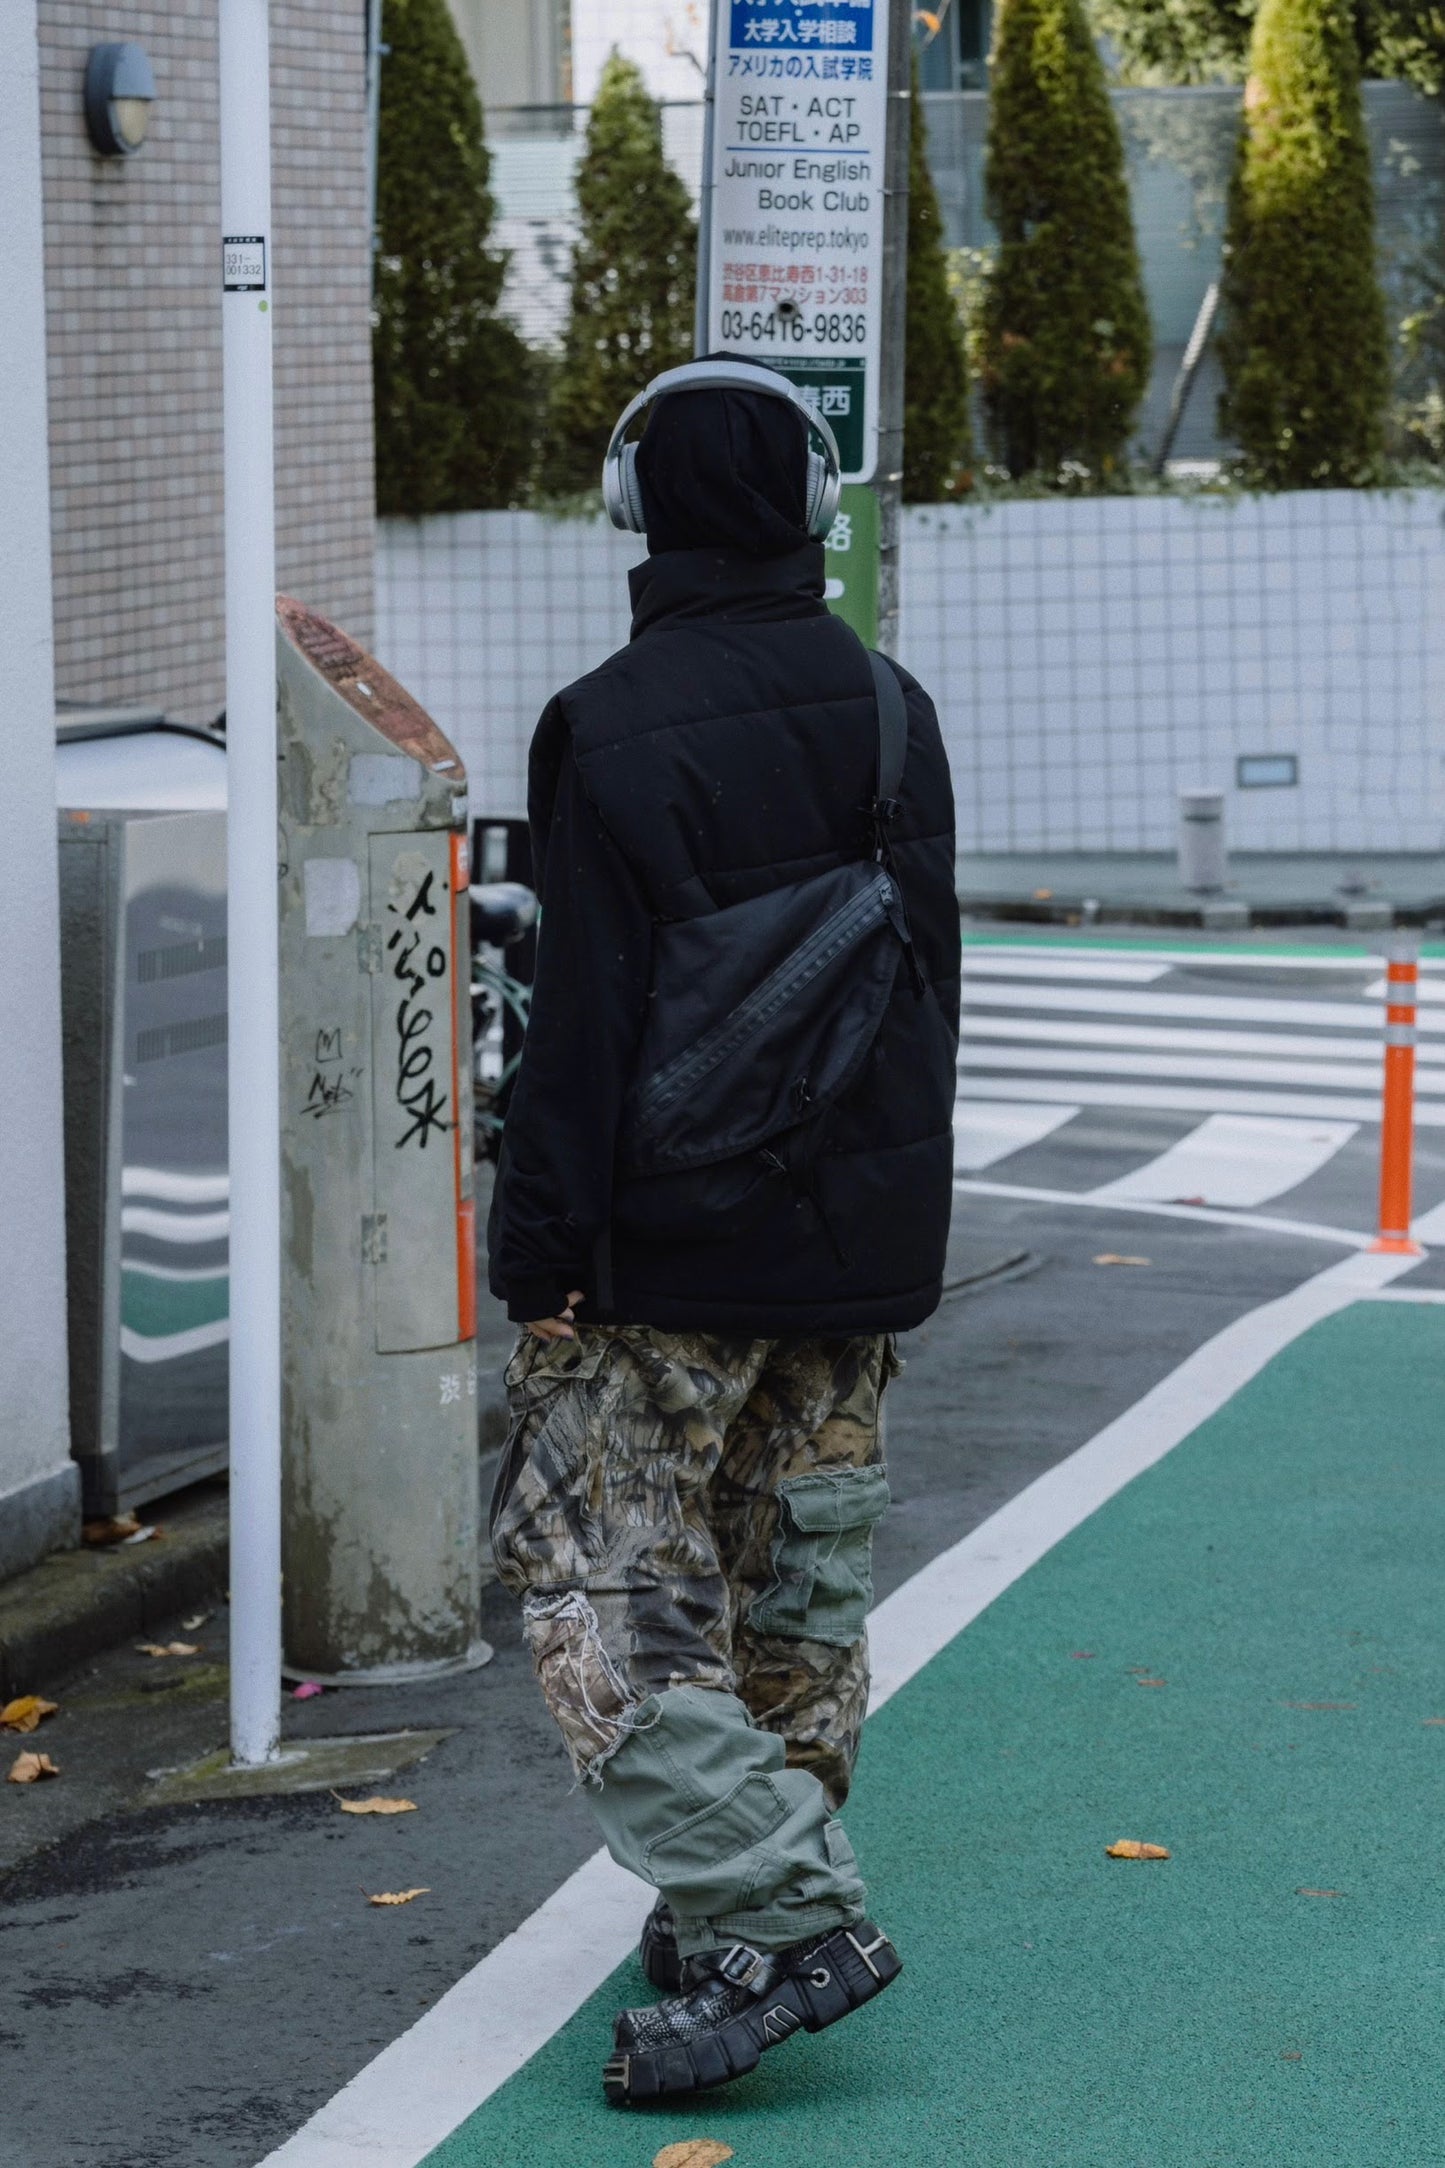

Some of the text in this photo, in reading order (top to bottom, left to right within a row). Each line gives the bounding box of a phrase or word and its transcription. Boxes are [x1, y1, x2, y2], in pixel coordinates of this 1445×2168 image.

[744, 18, 857, 44] 大学入学相談
[728, 55, 873, 81] アメリカの入試学院
[737, 121, 805, 142] TOEFL
[829, 124, 861, 143] AP
[725, 159, 871, 183] Junior English
[758, 189, 869, 211] Book Club
[723, 225, 869, 253] www.eliteprep.tokyo
[722, 310, 866, 342] 03-6416-9836
